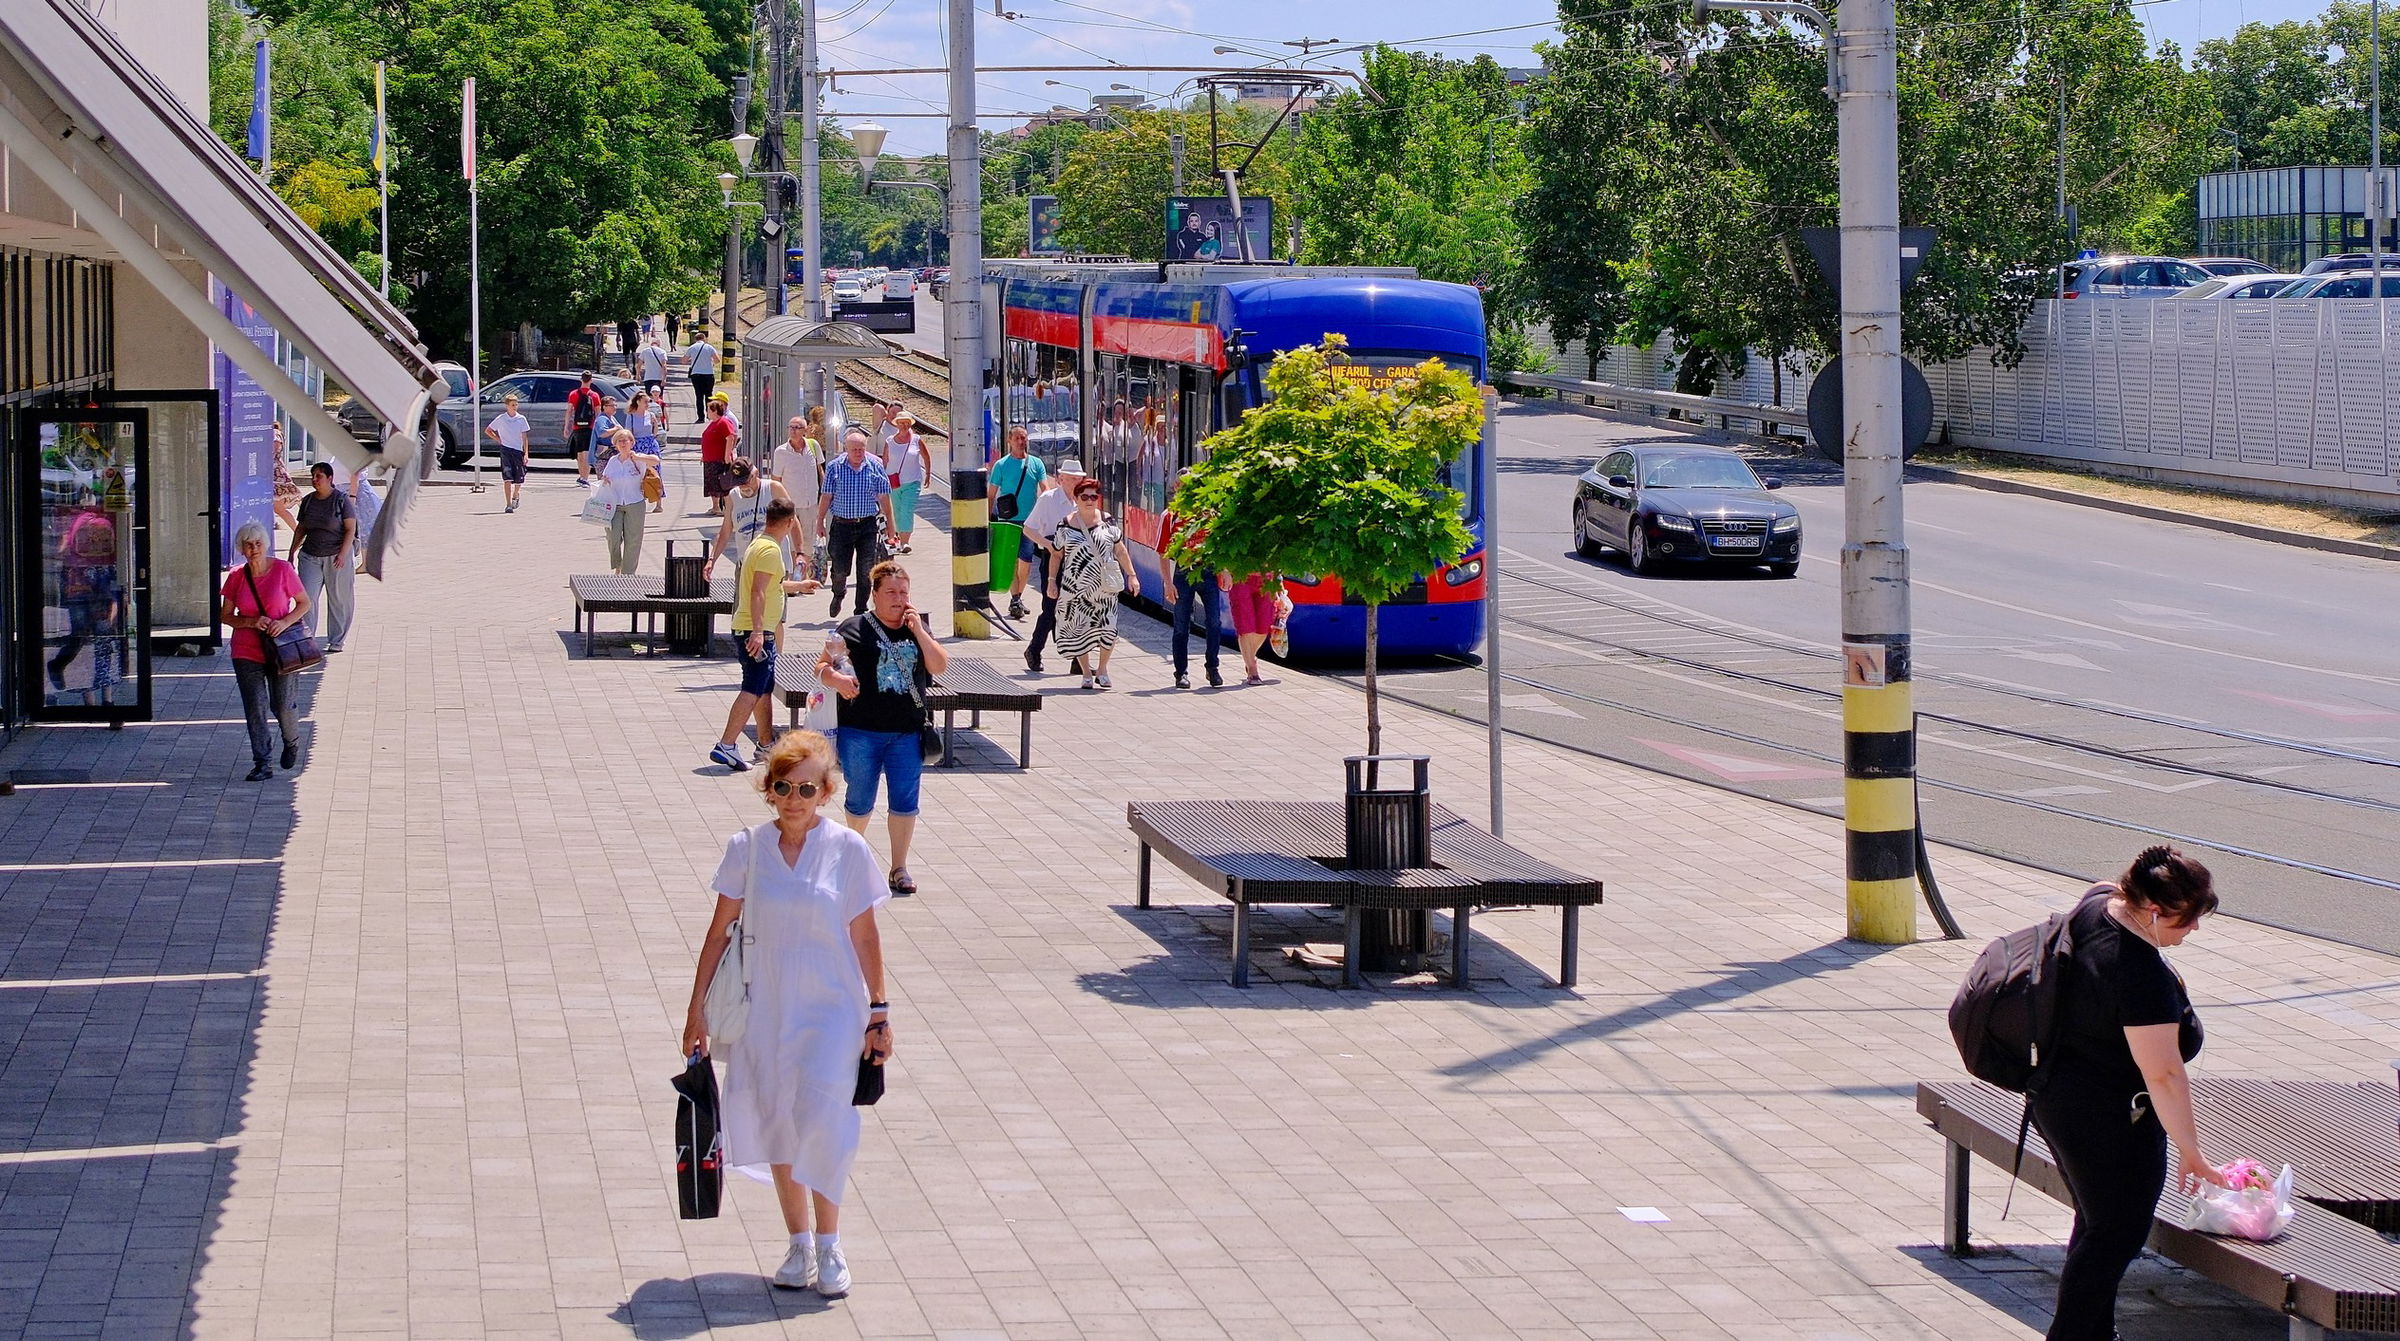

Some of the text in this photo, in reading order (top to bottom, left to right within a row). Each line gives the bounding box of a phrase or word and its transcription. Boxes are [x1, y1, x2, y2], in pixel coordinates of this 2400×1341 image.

[1386, 366, 1415, 378] GARA
[1373, 378, 1393, 389] CFR
[122, 424, 131, 435] 47
